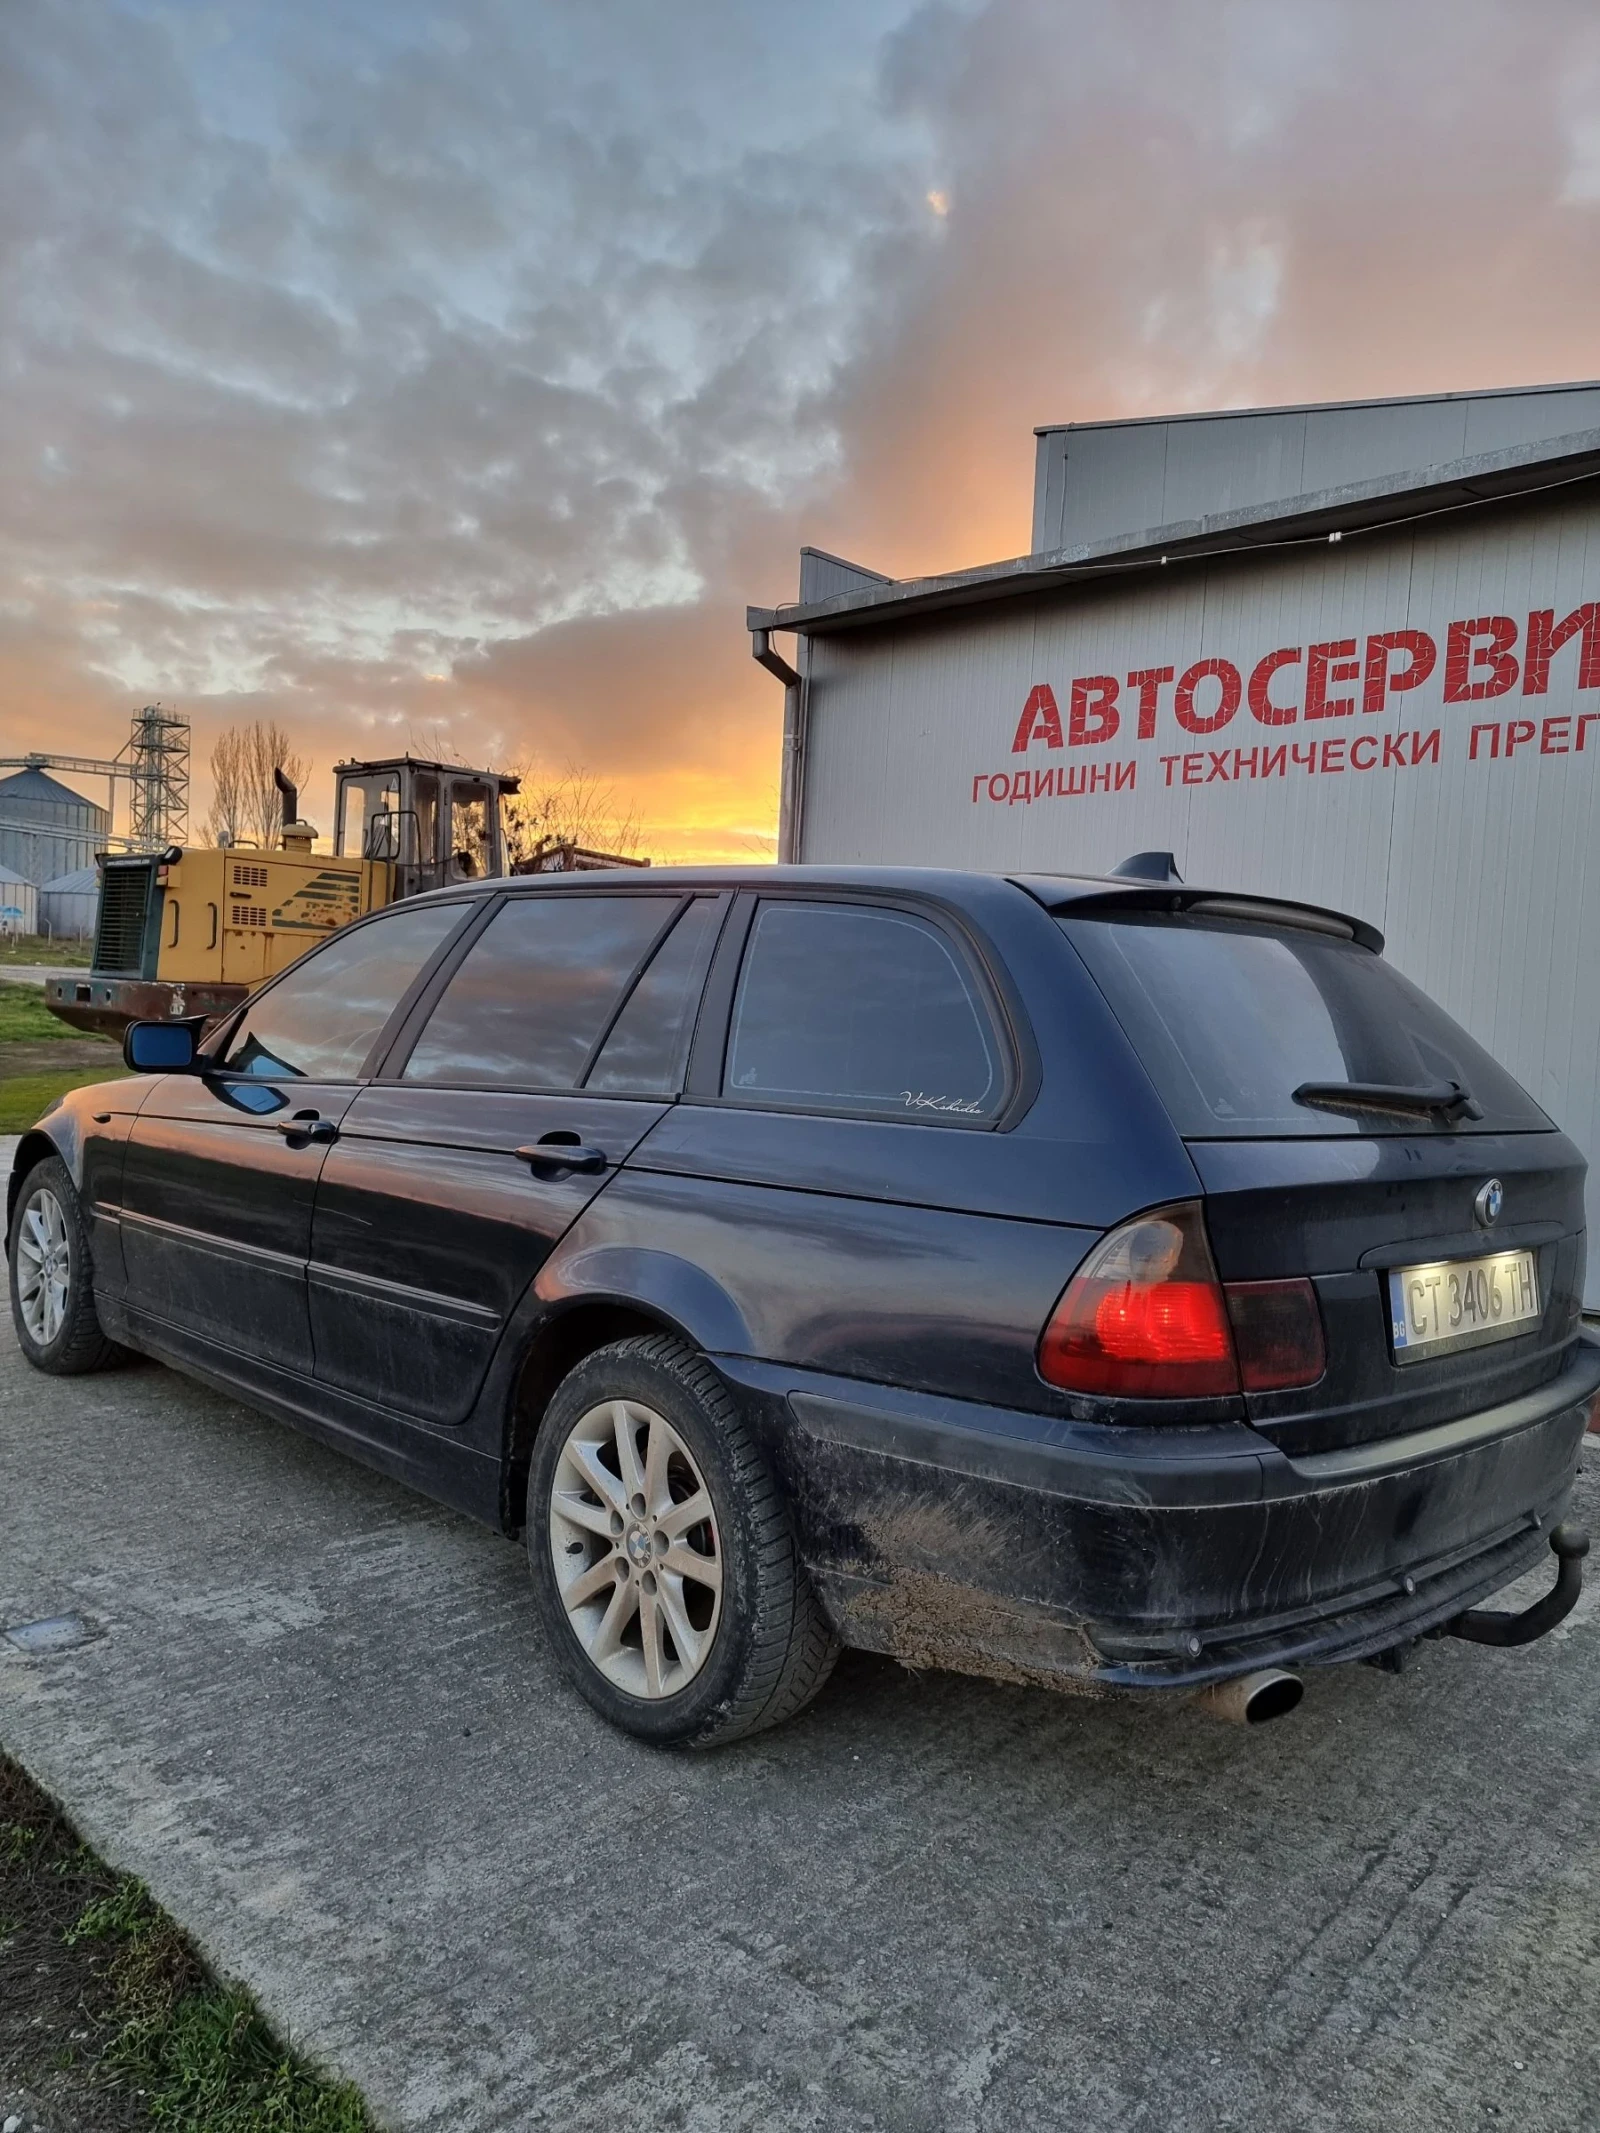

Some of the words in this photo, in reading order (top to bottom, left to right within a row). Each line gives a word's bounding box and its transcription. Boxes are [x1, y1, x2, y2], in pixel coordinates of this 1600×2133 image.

[1011, 602, 1600, 754] АВТОСЕРВИ
[972, 760, 1137, 806] ГОДИШНИ
[1160, 729, 1441, 787] ТЕХНИЧЕСКИ
[1469, 713, 1600, 760] ПРЕГ
[1393, 1321, 1406, 1338] BG
[1408, 1275, 1441, 1336] CT
[1448, 1265, 1503, 1327] 3406
[1504, 1259, 1533, 1316] TH
